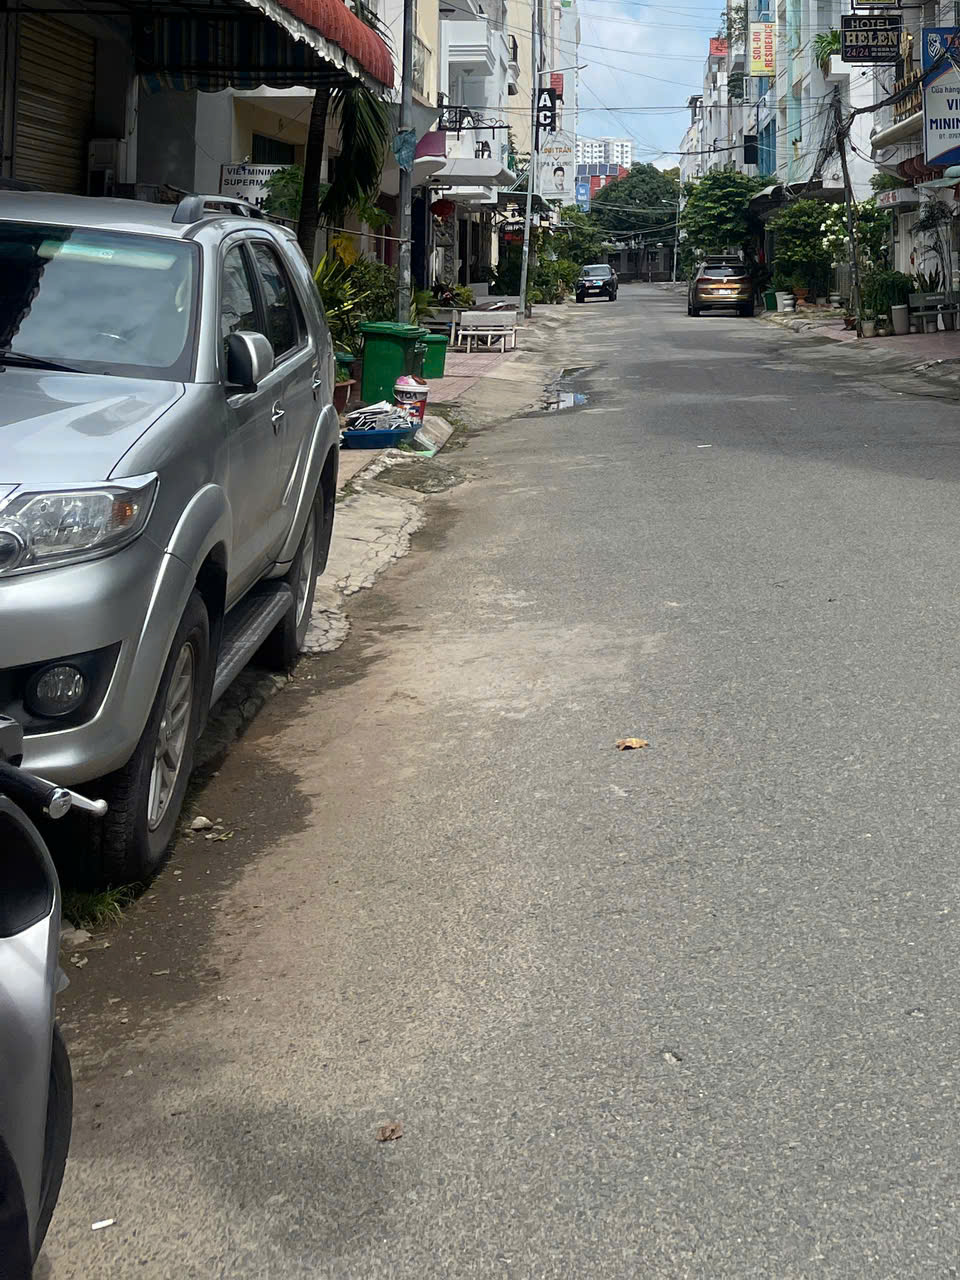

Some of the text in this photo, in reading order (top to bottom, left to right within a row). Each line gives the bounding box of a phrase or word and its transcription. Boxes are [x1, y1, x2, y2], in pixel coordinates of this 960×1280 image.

[851, 19, 889, 29] HOTEL
[845, 31, 899, 46] HELEN
[764, 23, 773, 68] RESIDENCE
[223, 178, 266, 187] SUPERM
